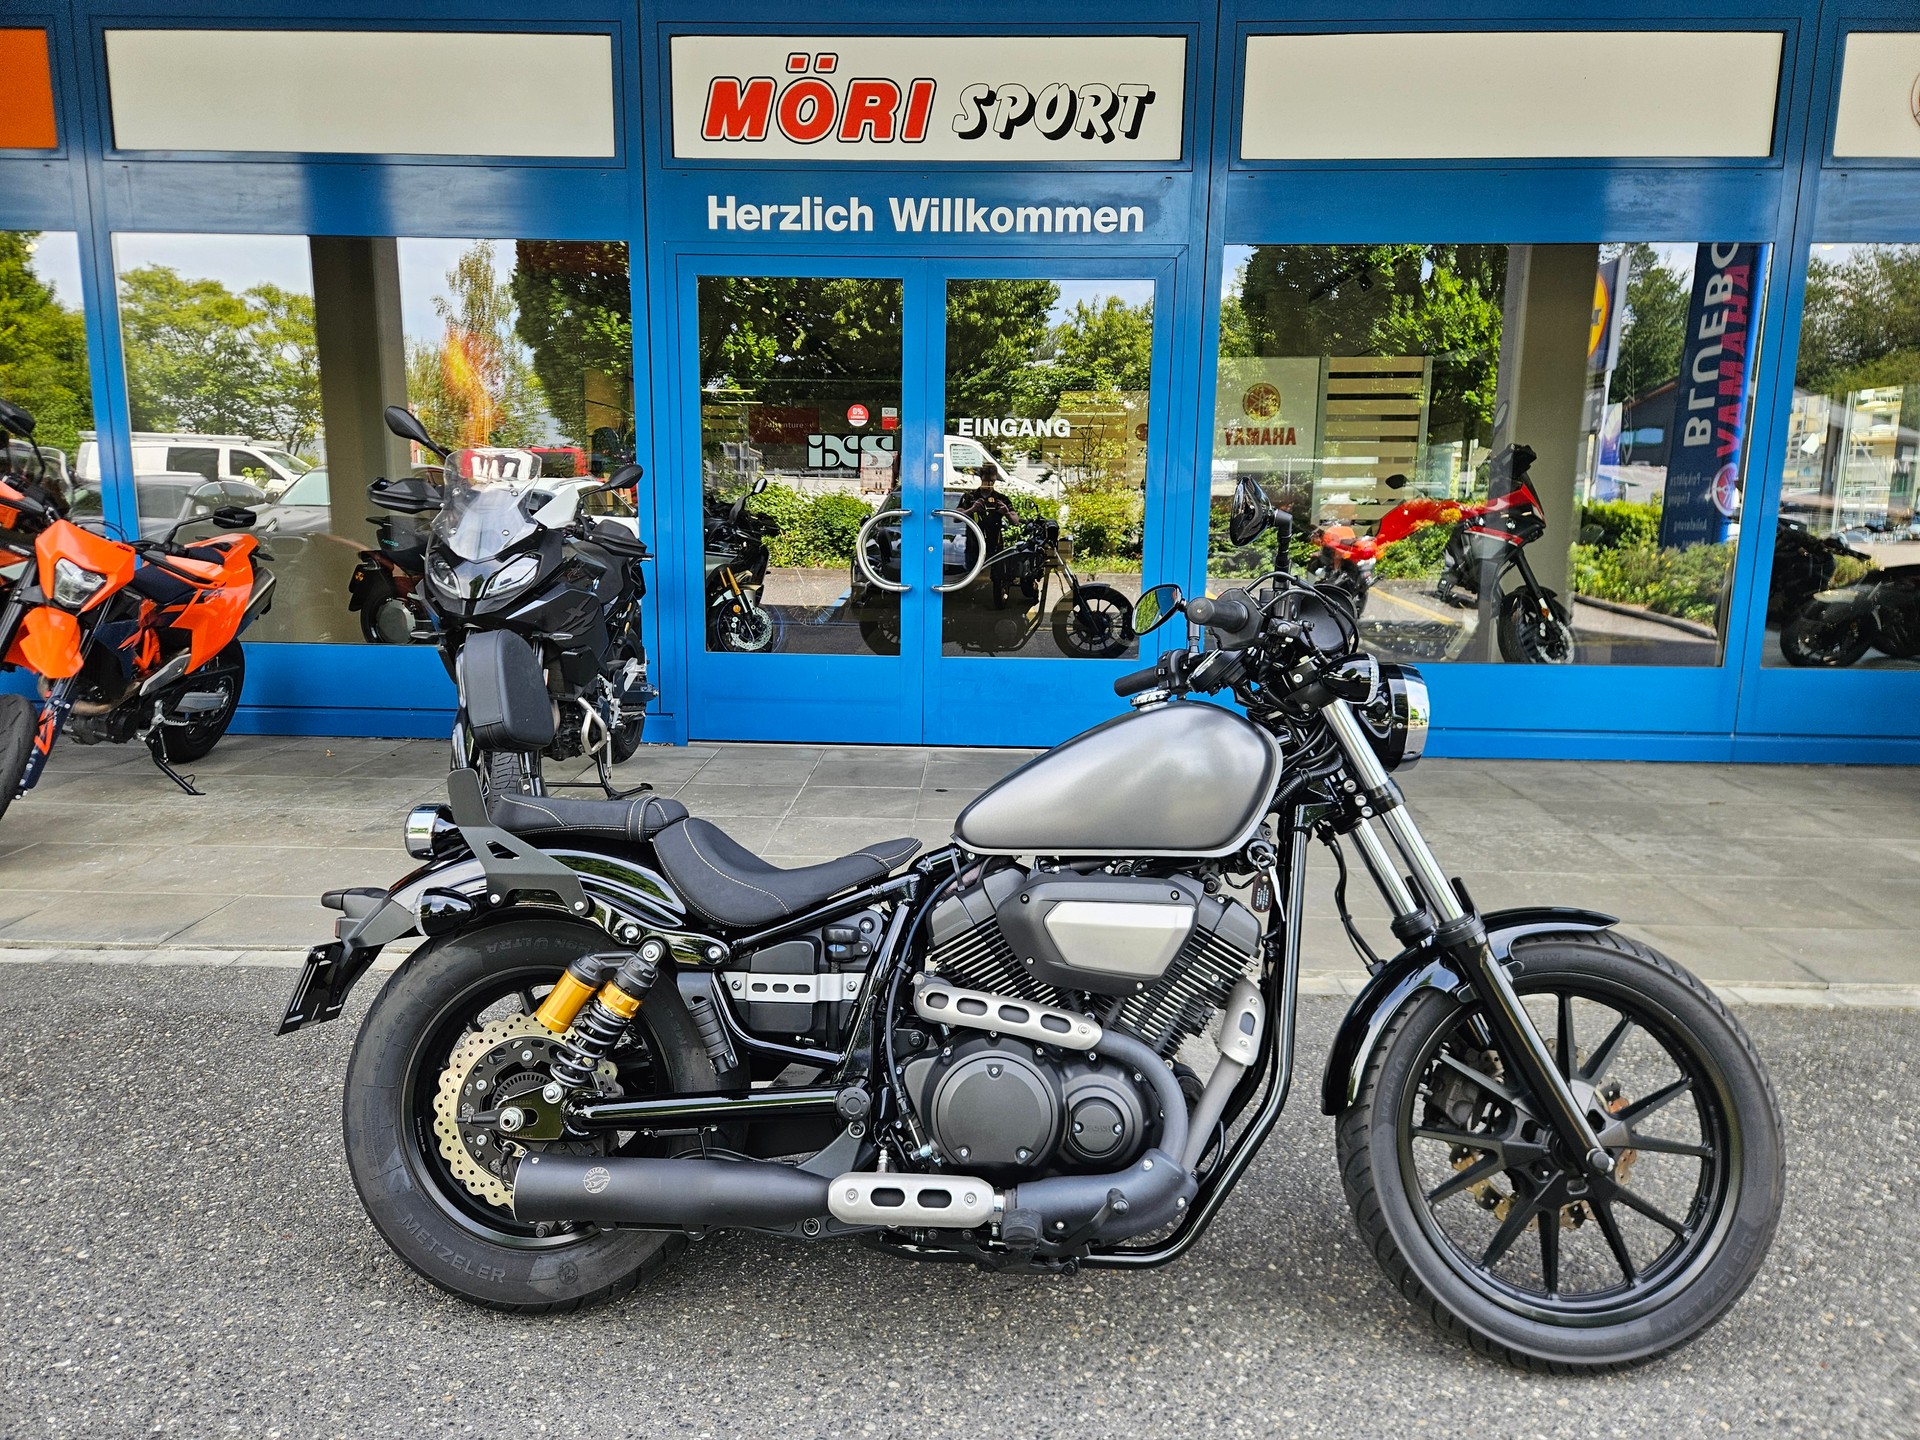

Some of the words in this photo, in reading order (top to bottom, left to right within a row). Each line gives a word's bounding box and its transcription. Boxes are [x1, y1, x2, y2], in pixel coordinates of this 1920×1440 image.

[701, 52, 937, 145] MÖRI
[952, 82, 1157, 144] SPORT
[707, 195, 874, 232] Herzlich
[889, 197, 1144, 233] Willkommen
[958, 417, 1071, 438] EINGANG
[1223, 426, 1297, 446] YAMAHA
[400, 1213, 506, 1284] METZELER
